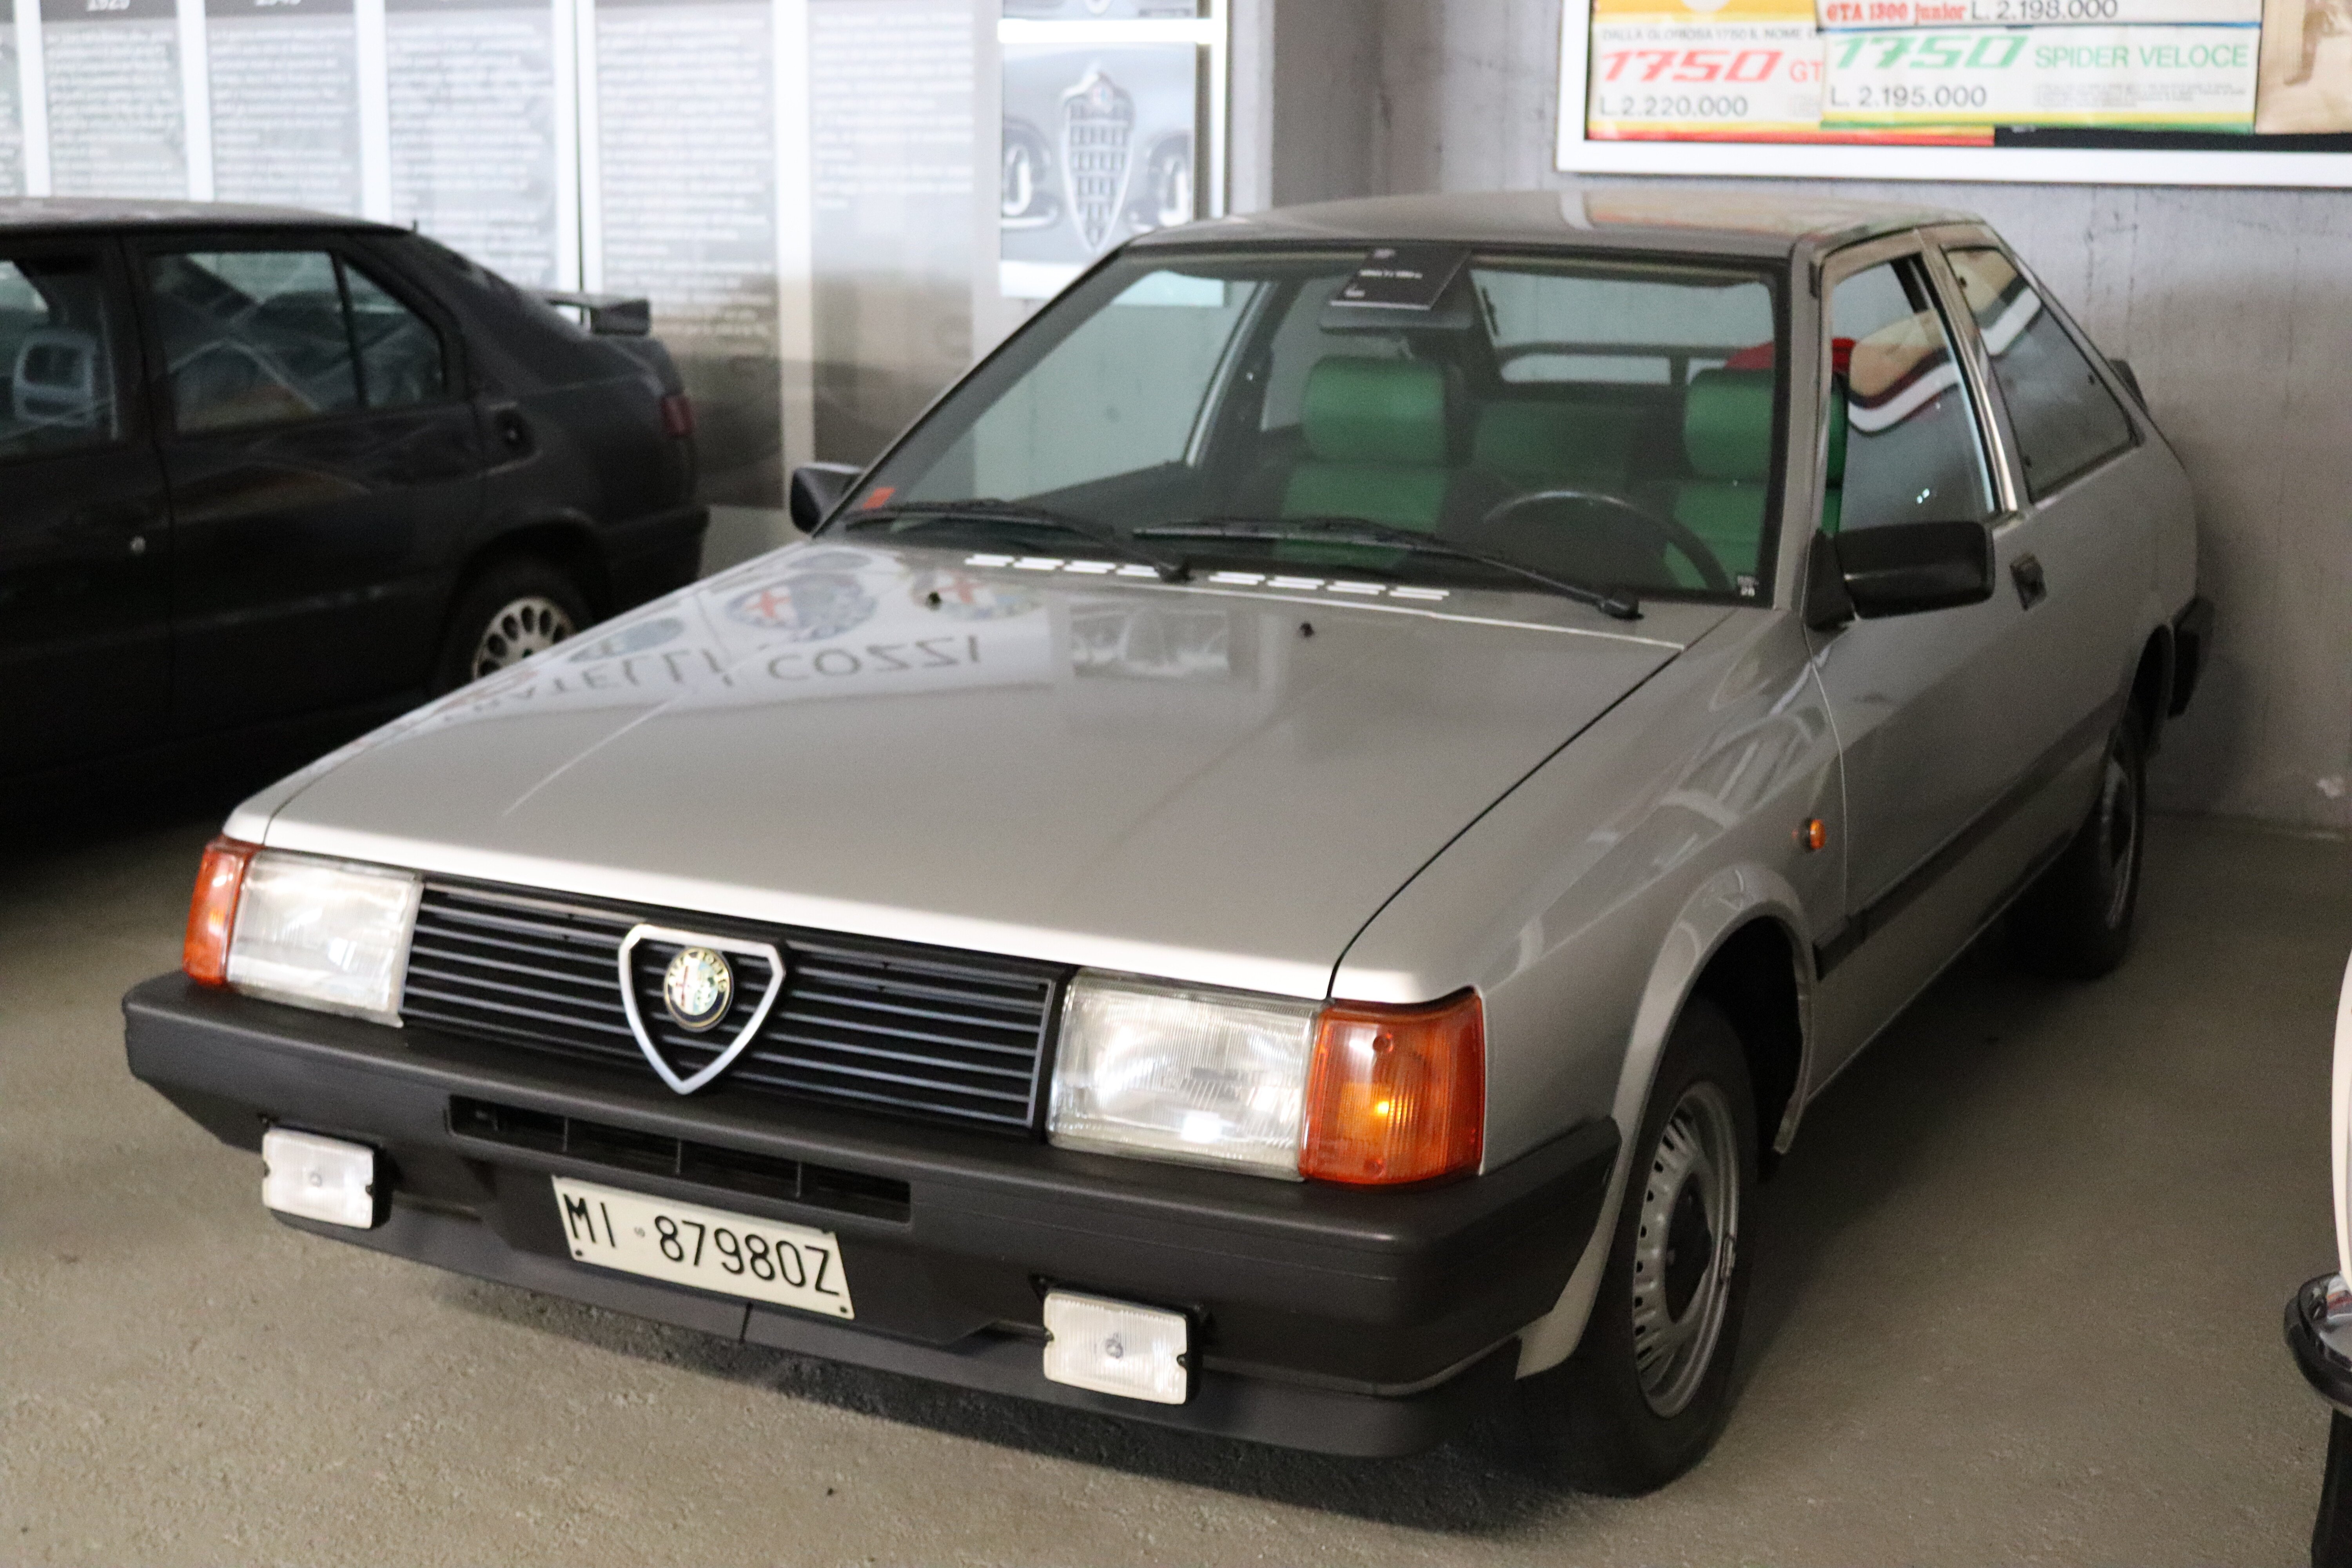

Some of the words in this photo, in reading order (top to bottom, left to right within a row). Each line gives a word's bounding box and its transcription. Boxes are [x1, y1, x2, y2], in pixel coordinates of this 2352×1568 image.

[1826, 3, 1863, 21] GTA
[1869, 2, 1908, 21] 1300
[1914, 2, 1966, 25] junior
[1997, 0, 2118, 20] 2.198.000
[1602, 49, 1785, 82] 1750
[1835, 34, 2029, 69] 1750
[2034, 45, 2129, 69] SPIDER
[2138, 44, 2249, 69] VELOCE
[1858, 84, 1987, 108] 2.195.000
[563, 1193, 616, 1249] MI
[653, 1214, 840, 1297] 87980Z
